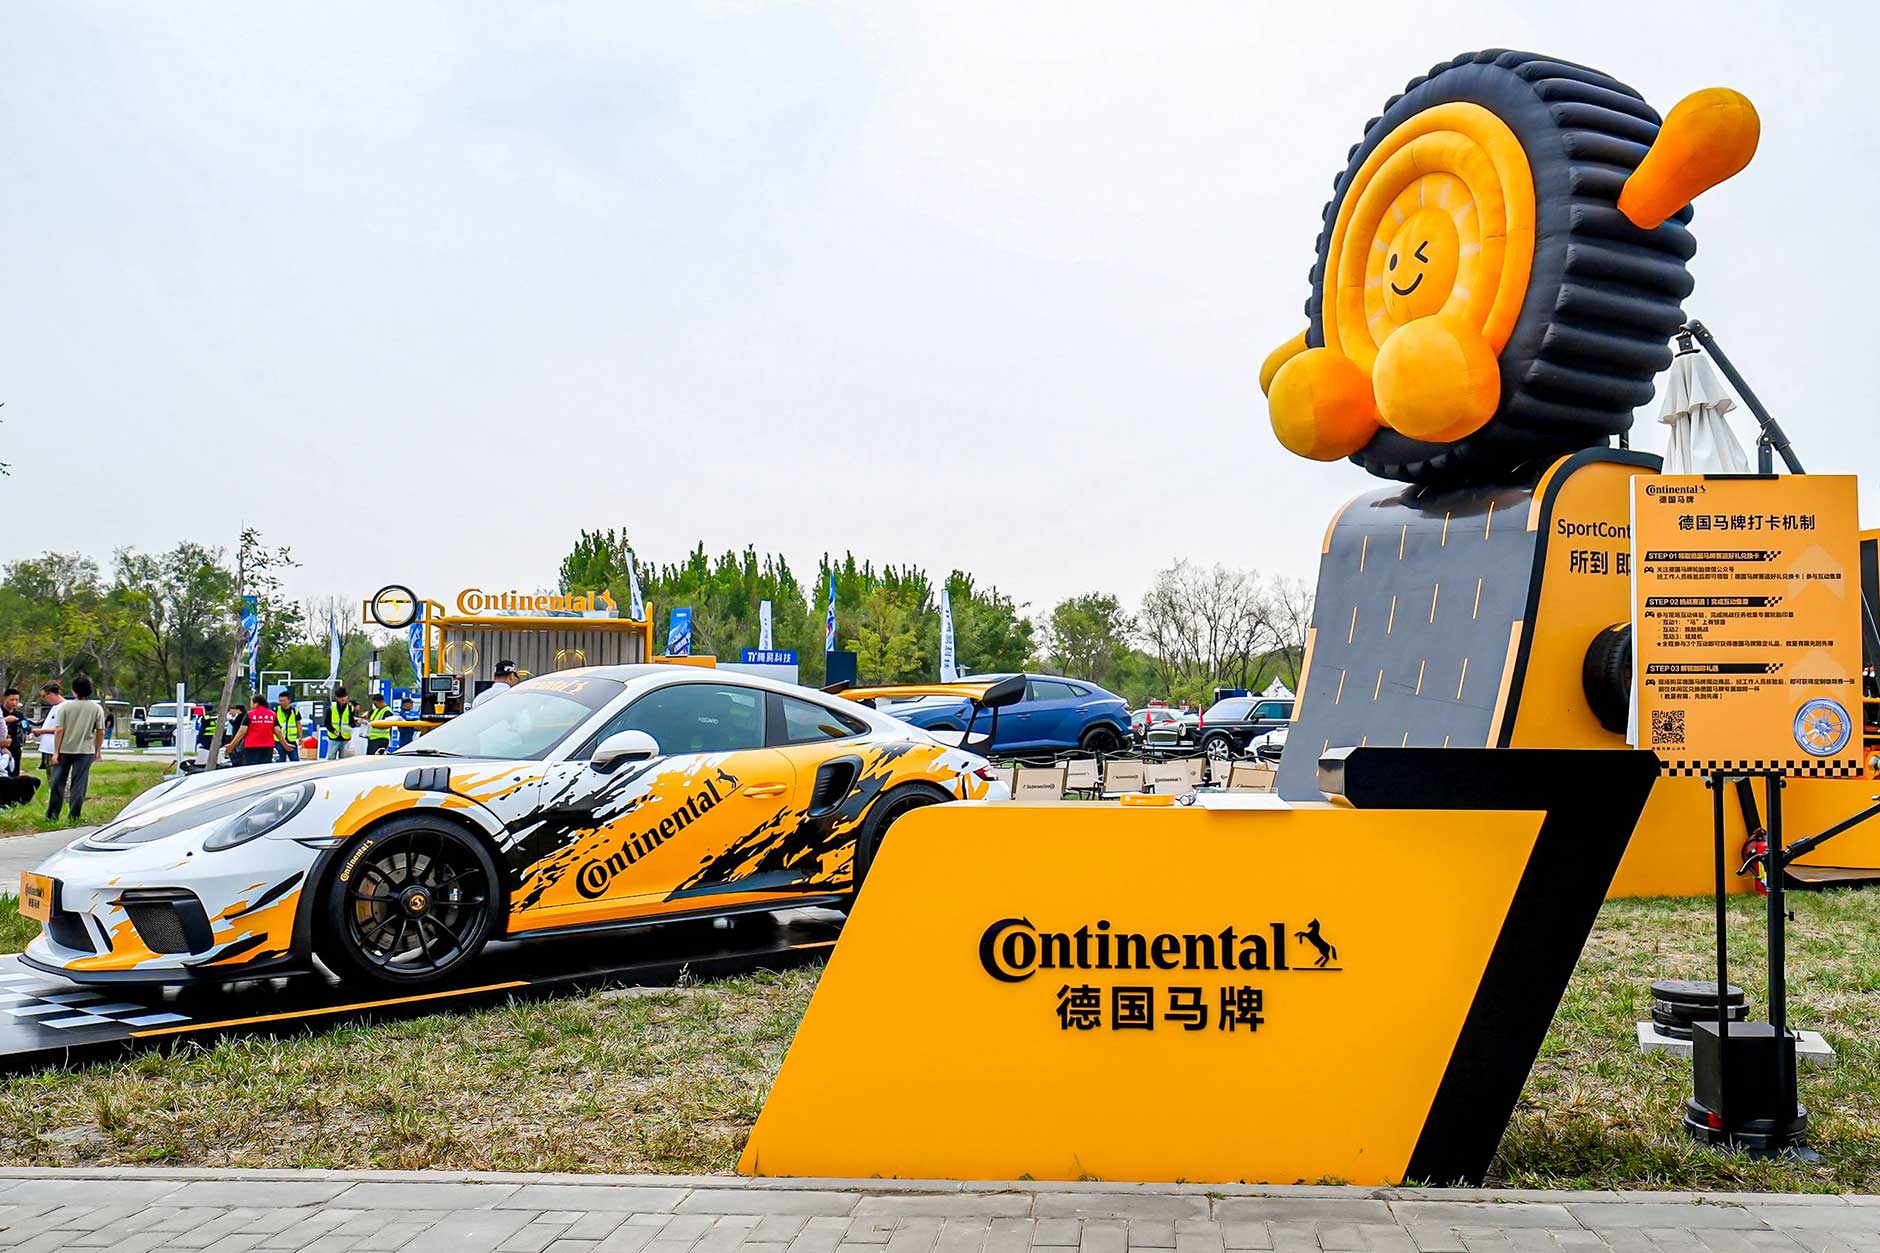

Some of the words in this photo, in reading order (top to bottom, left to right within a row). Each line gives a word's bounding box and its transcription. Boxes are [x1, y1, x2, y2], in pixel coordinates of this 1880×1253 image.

[1645, 484, 1698, 496] Continental
[1659, 496, 1694, 504] 德国马牌
[1557, 519, 1631, 539] SportCont
[1678, 514, 1816, 531] 德国马牌打卡机制
[1569, 550, 1608, 575] 所到
[1616, 552, 1631, 576] 即
[1648, 552, 1668, 560] STEP
[1669, 552, 1677, 560] 01
[457, 587, 596, 615] Continental
[1649, 598, 1669, 606] STEP
[1670, 598, 1679, 606] 02
[575, 779, 723, 900] Continental
[340, 843, 369, 882] Continental
[978, 915, 1289, 983] Continental
[1056, 984, 1265, 1032] 德国马牌
